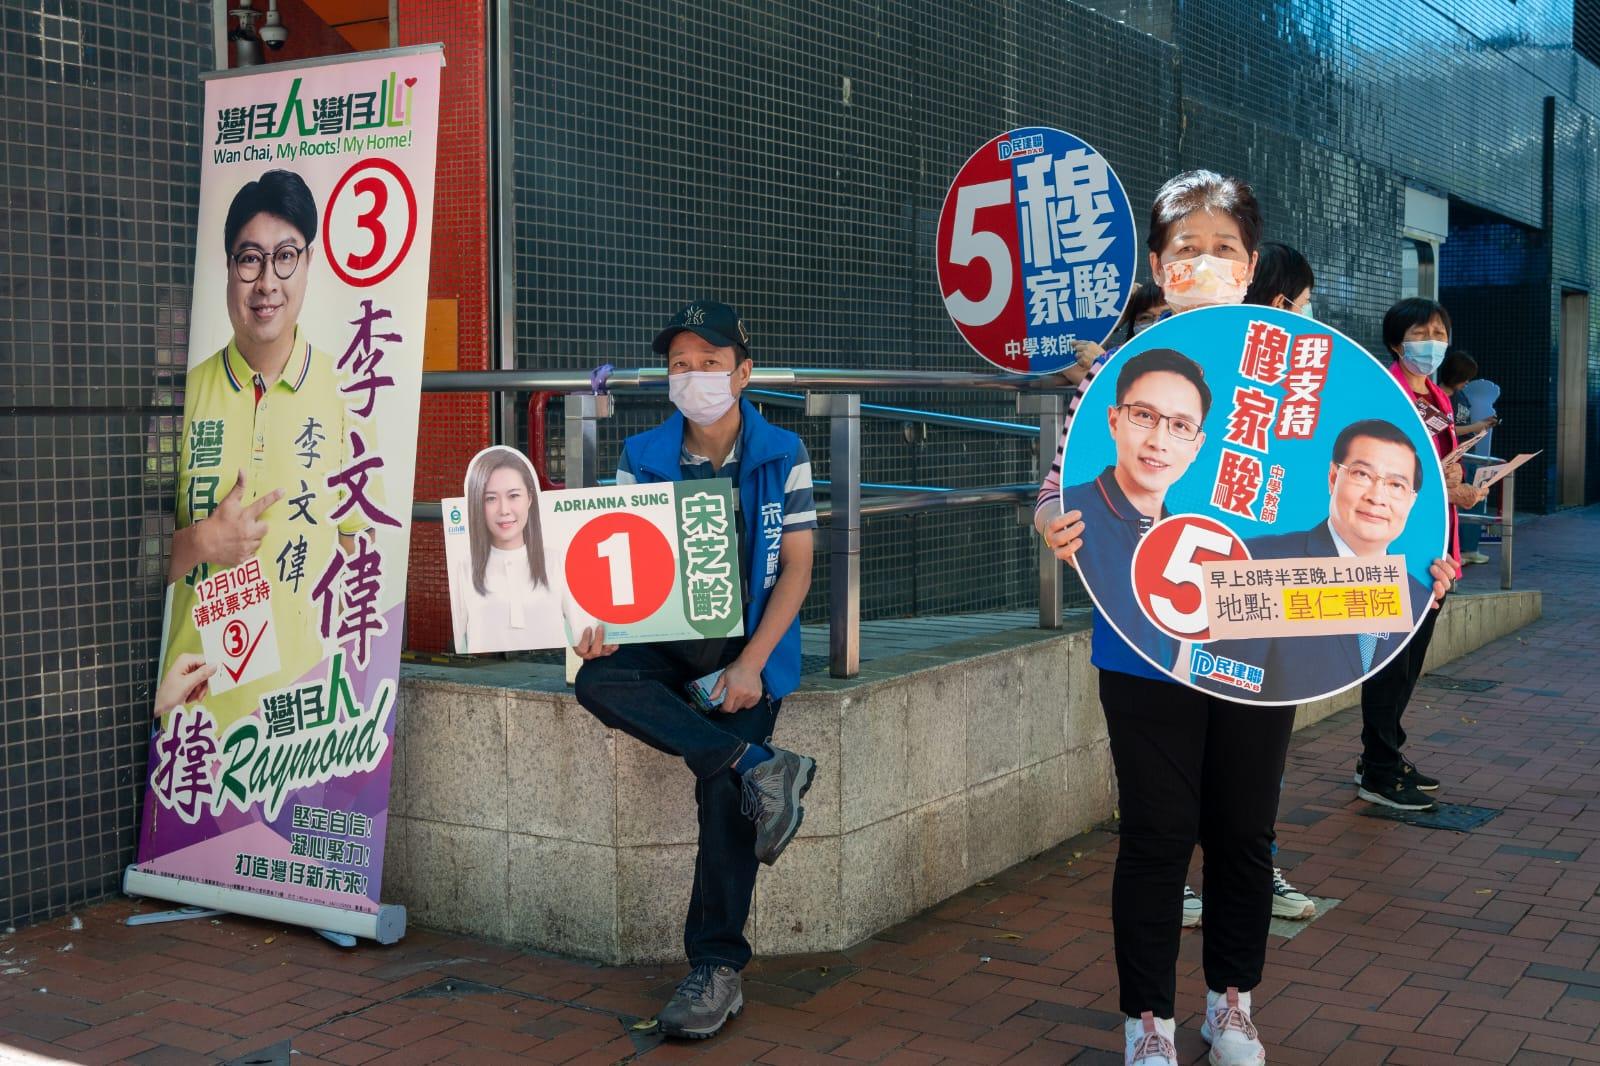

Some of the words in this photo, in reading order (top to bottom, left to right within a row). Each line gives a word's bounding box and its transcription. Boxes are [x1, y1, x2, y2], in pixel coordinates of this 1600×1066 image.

[213, 149, 241, 164] Wan
[243, 146, 273, 163] Chai,
[276, 143, 296, 161] My
[299, 137, 341, 157] Roots!
[343, 137, 364, 155] My
[366, 130, 412, 150] Home!
[346, 176, 389, 271] 3
[1016, 148, 1116, 267] 穆
[944, 178, 1013, 327] 5
[1025, 262, 1121, 326] 家駿
[1004, 333, 1076, 361] 中學教師
[1279, 337, 1329, 436] 我支持
[1212, 321, 1290, 520] 穆家駿
[275, 416, 326, 594] 李文偉
[312, 299, 403, 666] 李文偉
[553, 497, 627, 513] ADRIANNA
[631, 493, 669, 508] SUNG
[1261, 465, 1284, 523] 中學教師
[196, 559, 262, 602] 12月10日
[597, 532, 635, 607] 1
[683, 493, 732, 620] 宋芝齡
[1149, 523, 1233, 634] 5
[1210, 566, 1400, 588] 早上8時半至晚上10時半
[194, 581, 271, 628] 请投票支持
[1216, 592, 1279, 623] 地點:
[1288, 587, 1398, 620] 皇仁書院
[263, 652, 361, 739] 灣仔人
[1216, 655, 1265, 685] 民建聯
[216, 686, 389, 813] Raymond
[290, 833, 371, 867] 凝心聚力!
[293, 804, 373, 838] 堅定自信!
[234, 853, 368, 896] 打造灣仔新未來!
